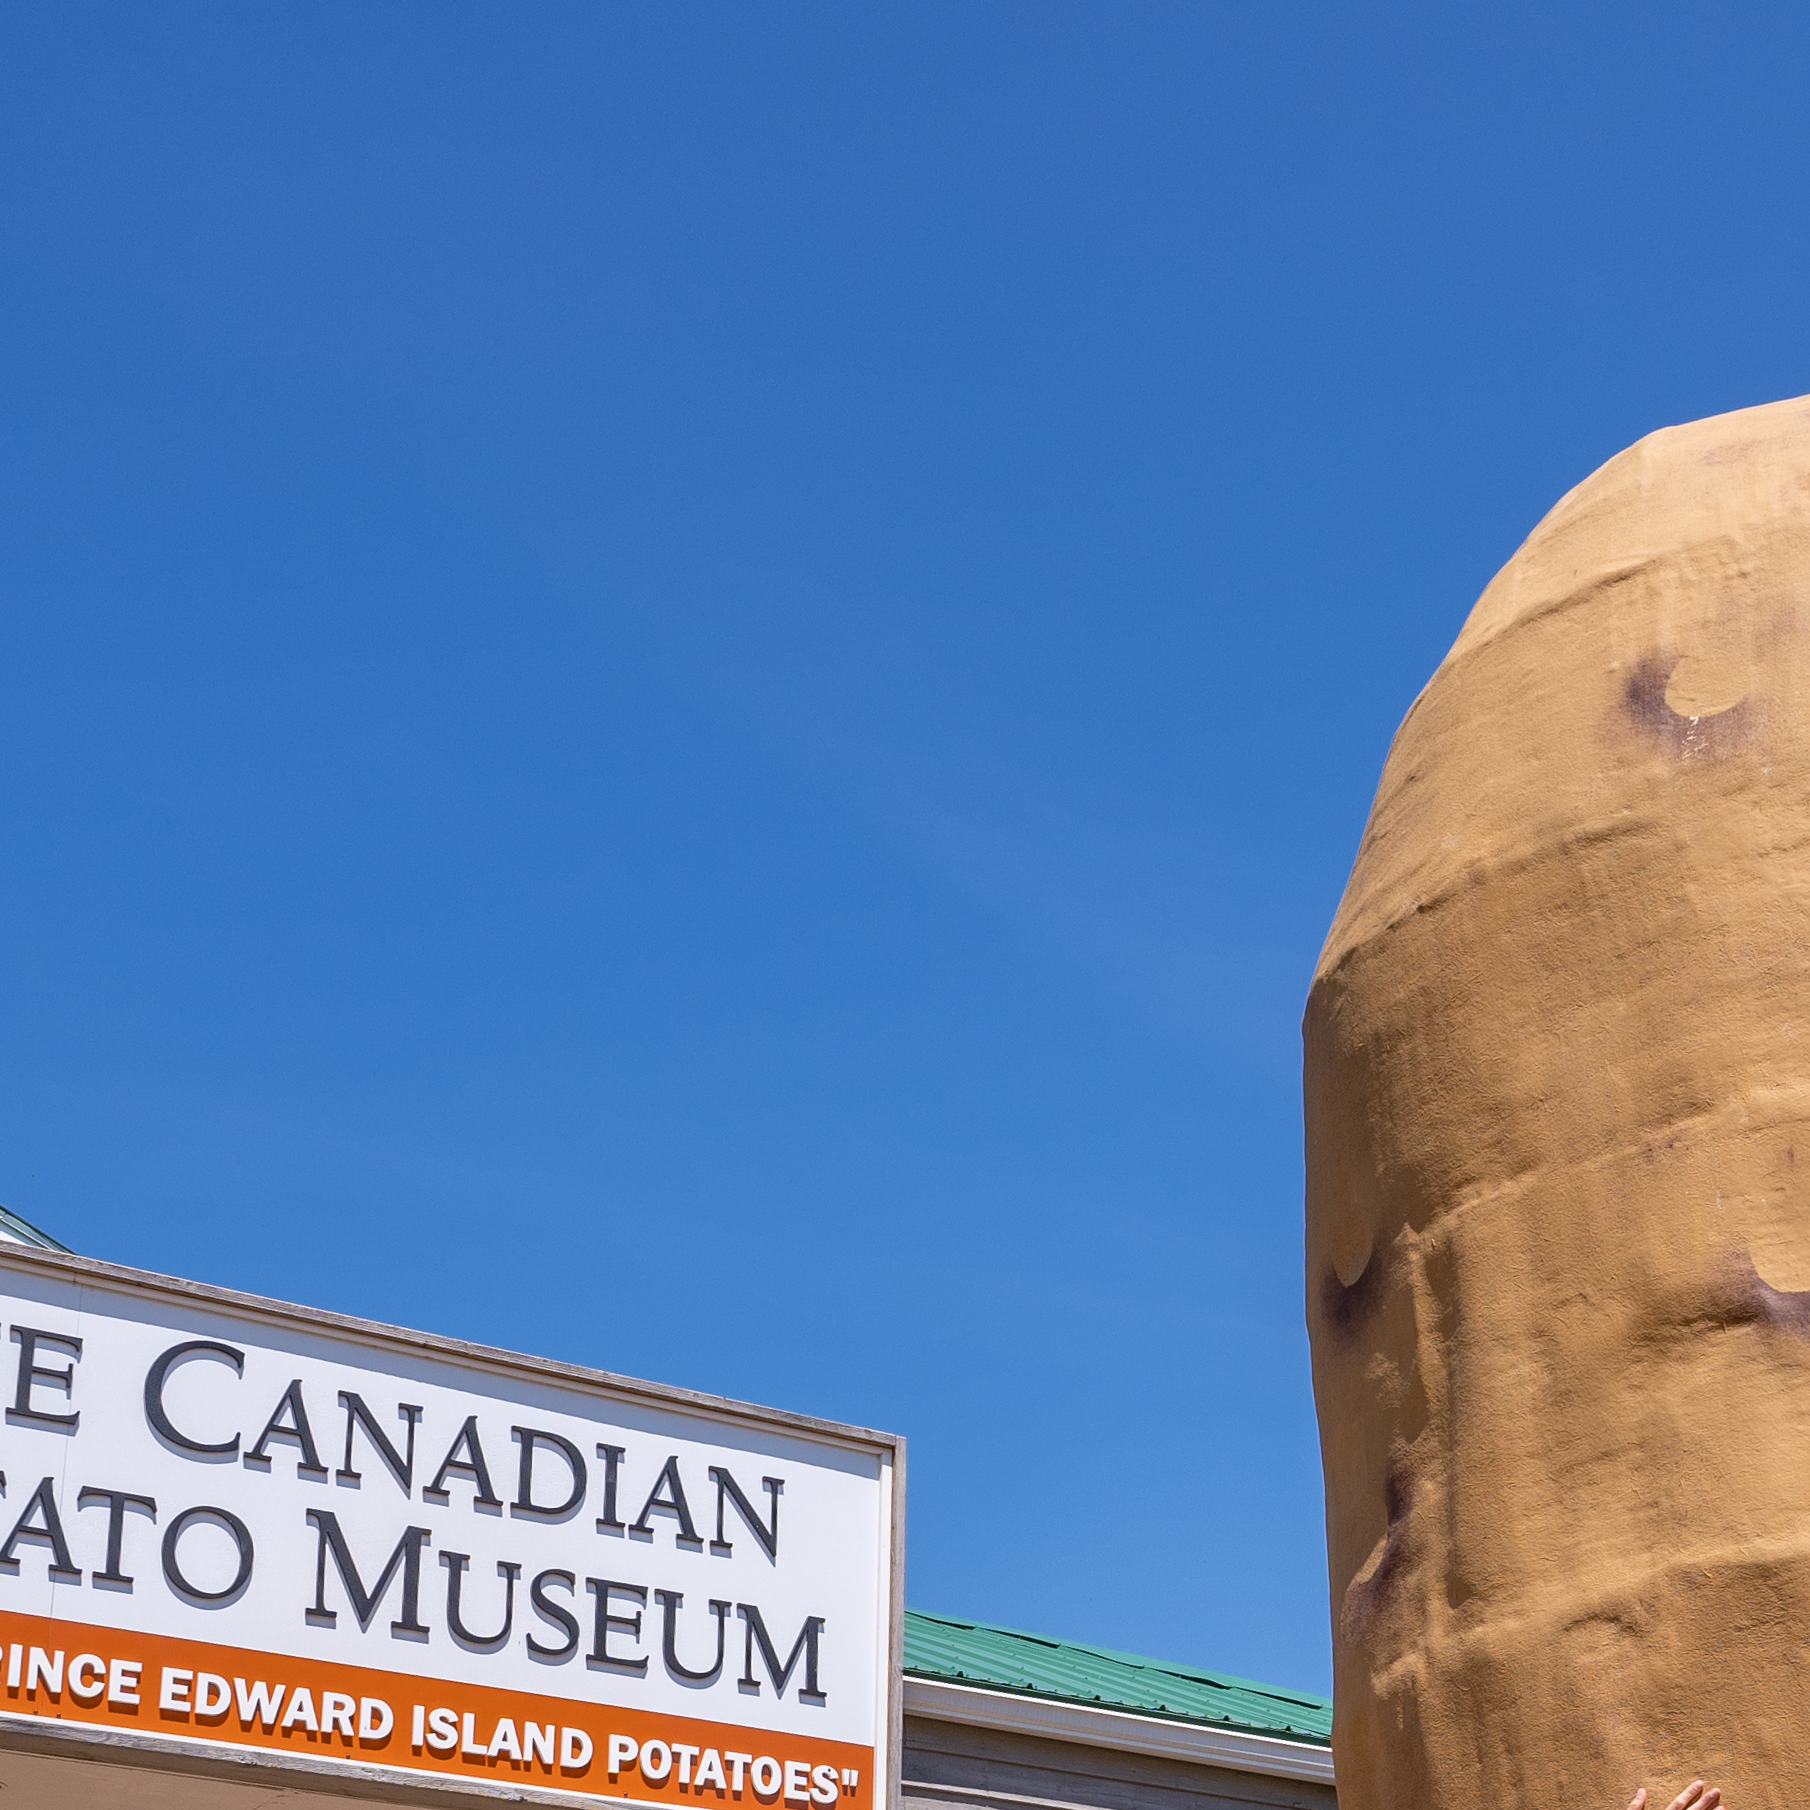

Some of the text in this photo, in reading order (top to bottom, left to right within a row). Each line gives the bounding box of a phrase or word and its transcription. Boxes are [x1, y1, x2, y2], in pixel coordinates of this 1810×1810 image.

[144, 1340, 785, 1560] CANADIAN
[306, 1508, 827, 1698] MUSEUM
[160, 1667, 394, 1741] EDWARD
[413, 1704, 593, 1770] ISLAND
